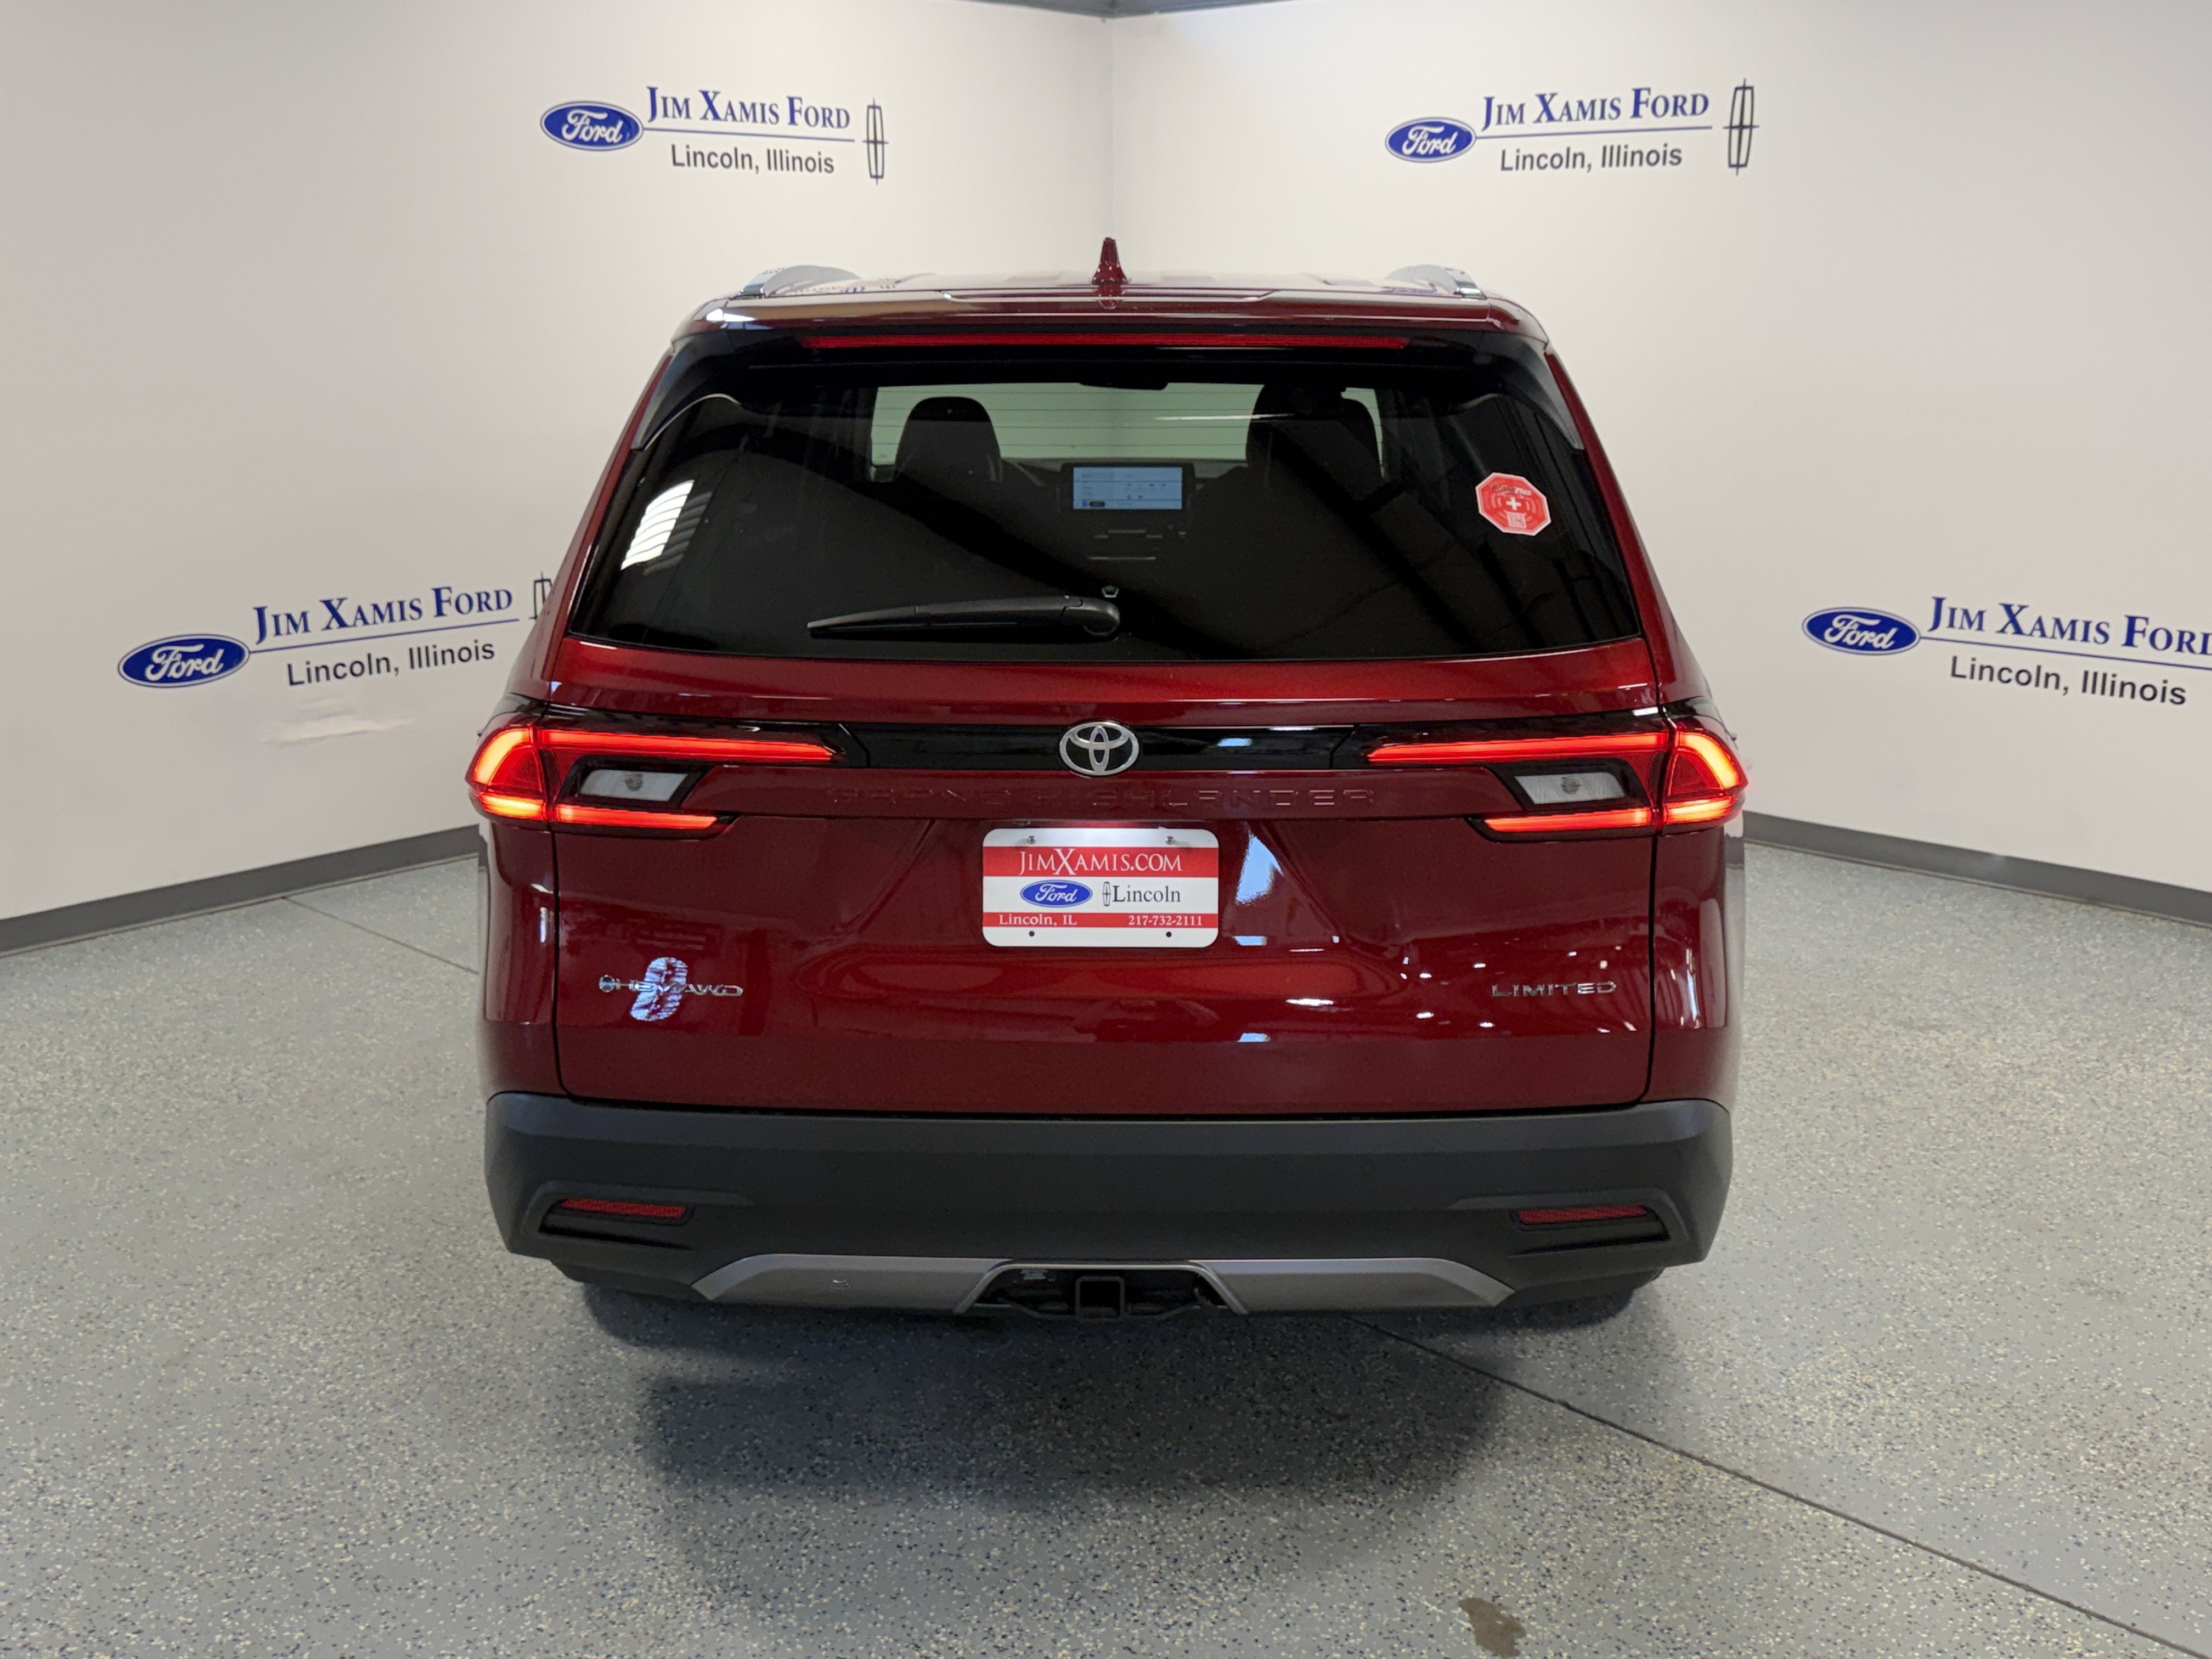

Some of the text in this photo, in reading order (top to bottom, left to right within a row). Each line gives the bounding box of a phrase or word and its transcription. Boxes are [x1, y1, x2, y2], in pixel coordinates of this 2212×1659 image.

[646, 86, 850, 129] JIM XAMIS FORD
[1481, 87, 1709, 131] JIM XAMIS FORD
[561, 109, 623, 144] Ford
[1402, 124, 1457, 155] Ford
[672, 144, 835, 174] Lincoln, Illinois
[1500, 143, 1683, 172] Lincoln, Illinois
[252, 585, 513, 645] JIM XAMIS FORD
[1927, 596, 1986, 633] JIM
[1995, 602, 2111, 646] XAMIS
[1823, 613, 1899, 651] Ford
[144, 644, 225, 682] Ford
[287, 639, 495, 687] Lincoln, Illinois
[1950, 655, 2187, 706] Lincoln, Illinois
[1030, 788, 1374, 808] HGHLANDER
[1035, 884, 1078, 903] Ford
[1112, 884, 1181, 903] Lincoln
[998, 913, 1077, 927] Lincoln, IL
[1127, 915, 1203, 927] 217-732-2111
[1491, 980, 1617, 997] LIMITED
